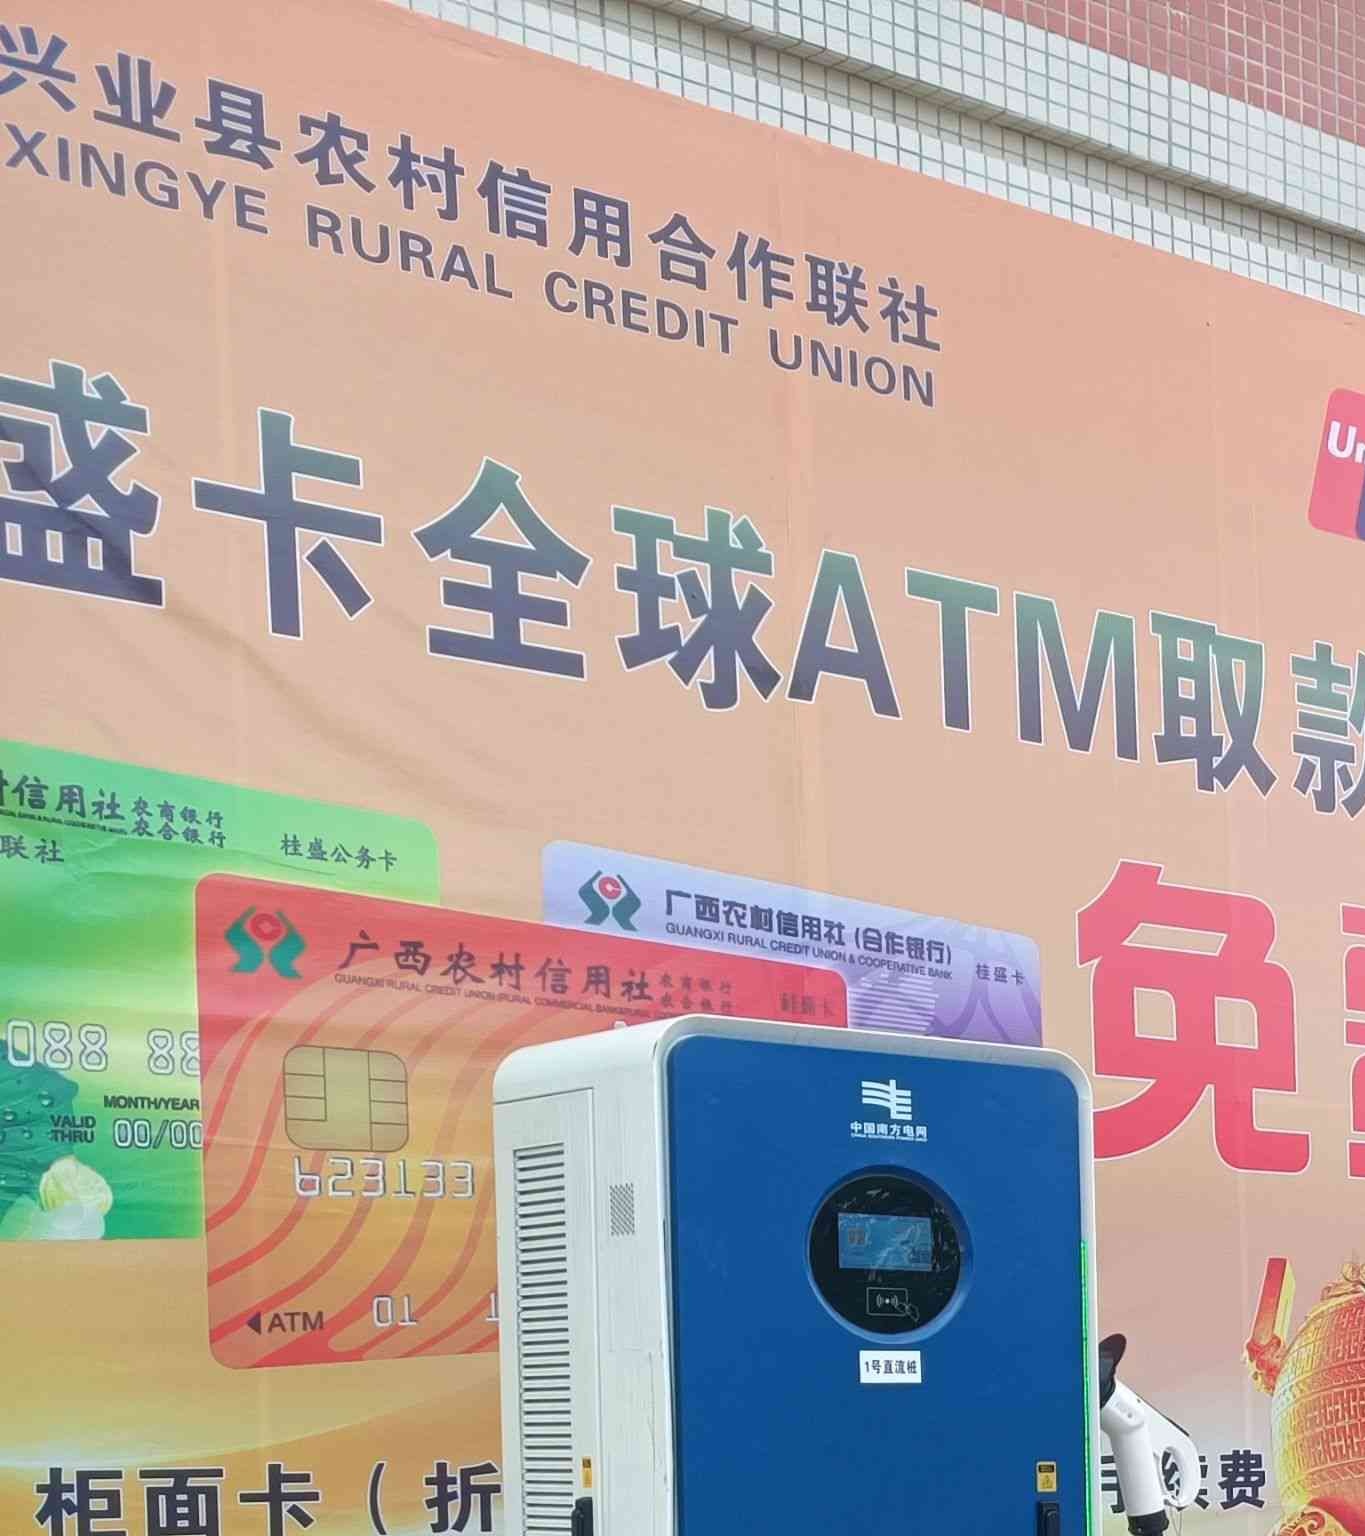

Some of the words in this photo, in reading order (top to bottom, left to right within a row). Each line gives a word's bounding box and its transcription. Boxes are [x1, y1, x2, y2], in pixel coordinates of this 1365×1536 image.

[0, 25, 942, 351] 兴业县农村信用合作联社
[5, 122, 270, 235] XINGYE
[305, 204, 514, 299] RURAL
[543, 270, 738, 355] CREDIT
[769, 326, 936, 407] UNION
[0, 769, 125, 821] 信用社
[280, 833, 398, 872] 桂盛公务卡
[666, 922, 725, 942] GUANGXI
[727, 932, 768, 950] RURAL
[770, 939, 810, 956] CREDIT
[812, 946, 846, 962] UNION
[337, 929, 654, 1002] 广西农村信用社
[976, 963, 1025, 985] 桂盛卡
[103, 1095, 200, 1112] MONTH/YEAR
[51, 1115, 96, 1129] VALID
[113, 1118, 203, 1149] 00/00
[52, 1129, 94, 1143] THRU
[850, 1121, 928, 1137] 中国南方电网
[294, 1155, 476, 1198] 623133
[267, 1311, 325, 1334] ATM
